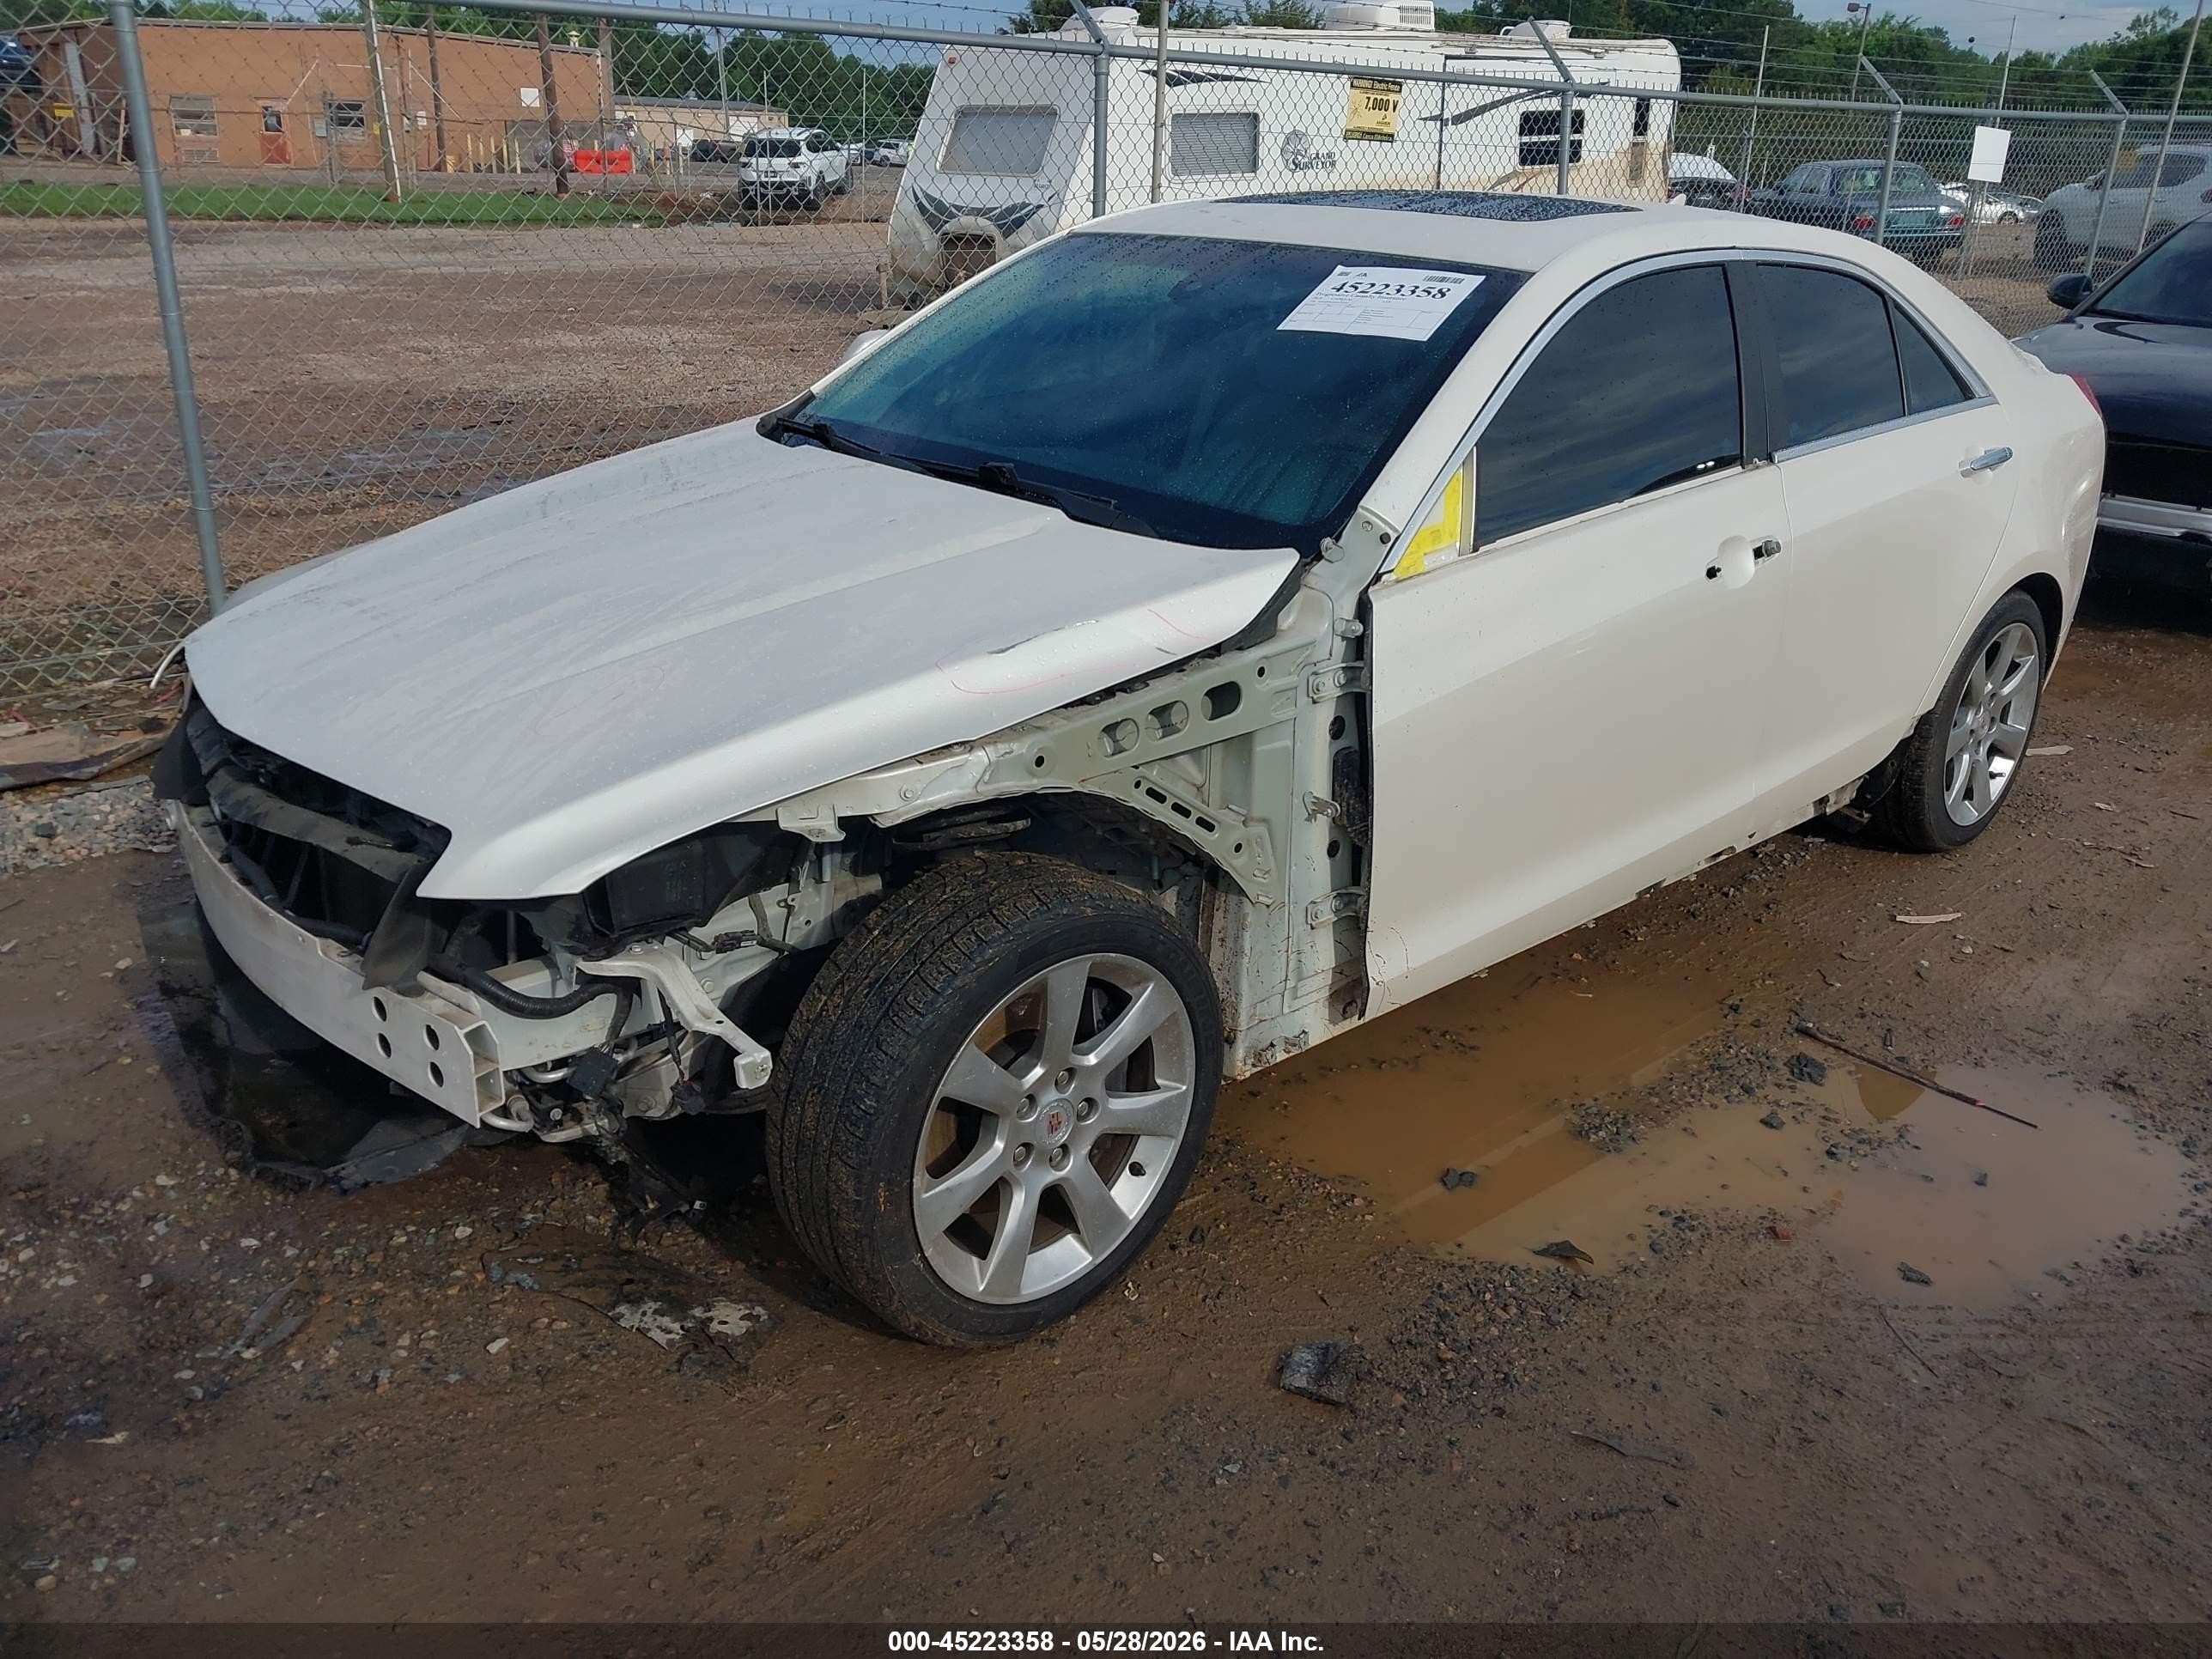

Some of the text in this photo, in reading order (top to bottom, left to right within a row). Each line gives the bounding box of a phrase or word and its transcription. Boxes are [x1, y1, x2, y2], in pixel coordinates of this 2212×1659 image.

[1373, 81, 1388, 90] Electric
[1388, 82, 1401, 91] Fence
[1365, 96, 1400, 112] 7,000 V
[1310, 151, 1336, 160] GRAND
[1331, 281, 1451, 300] 45223358
